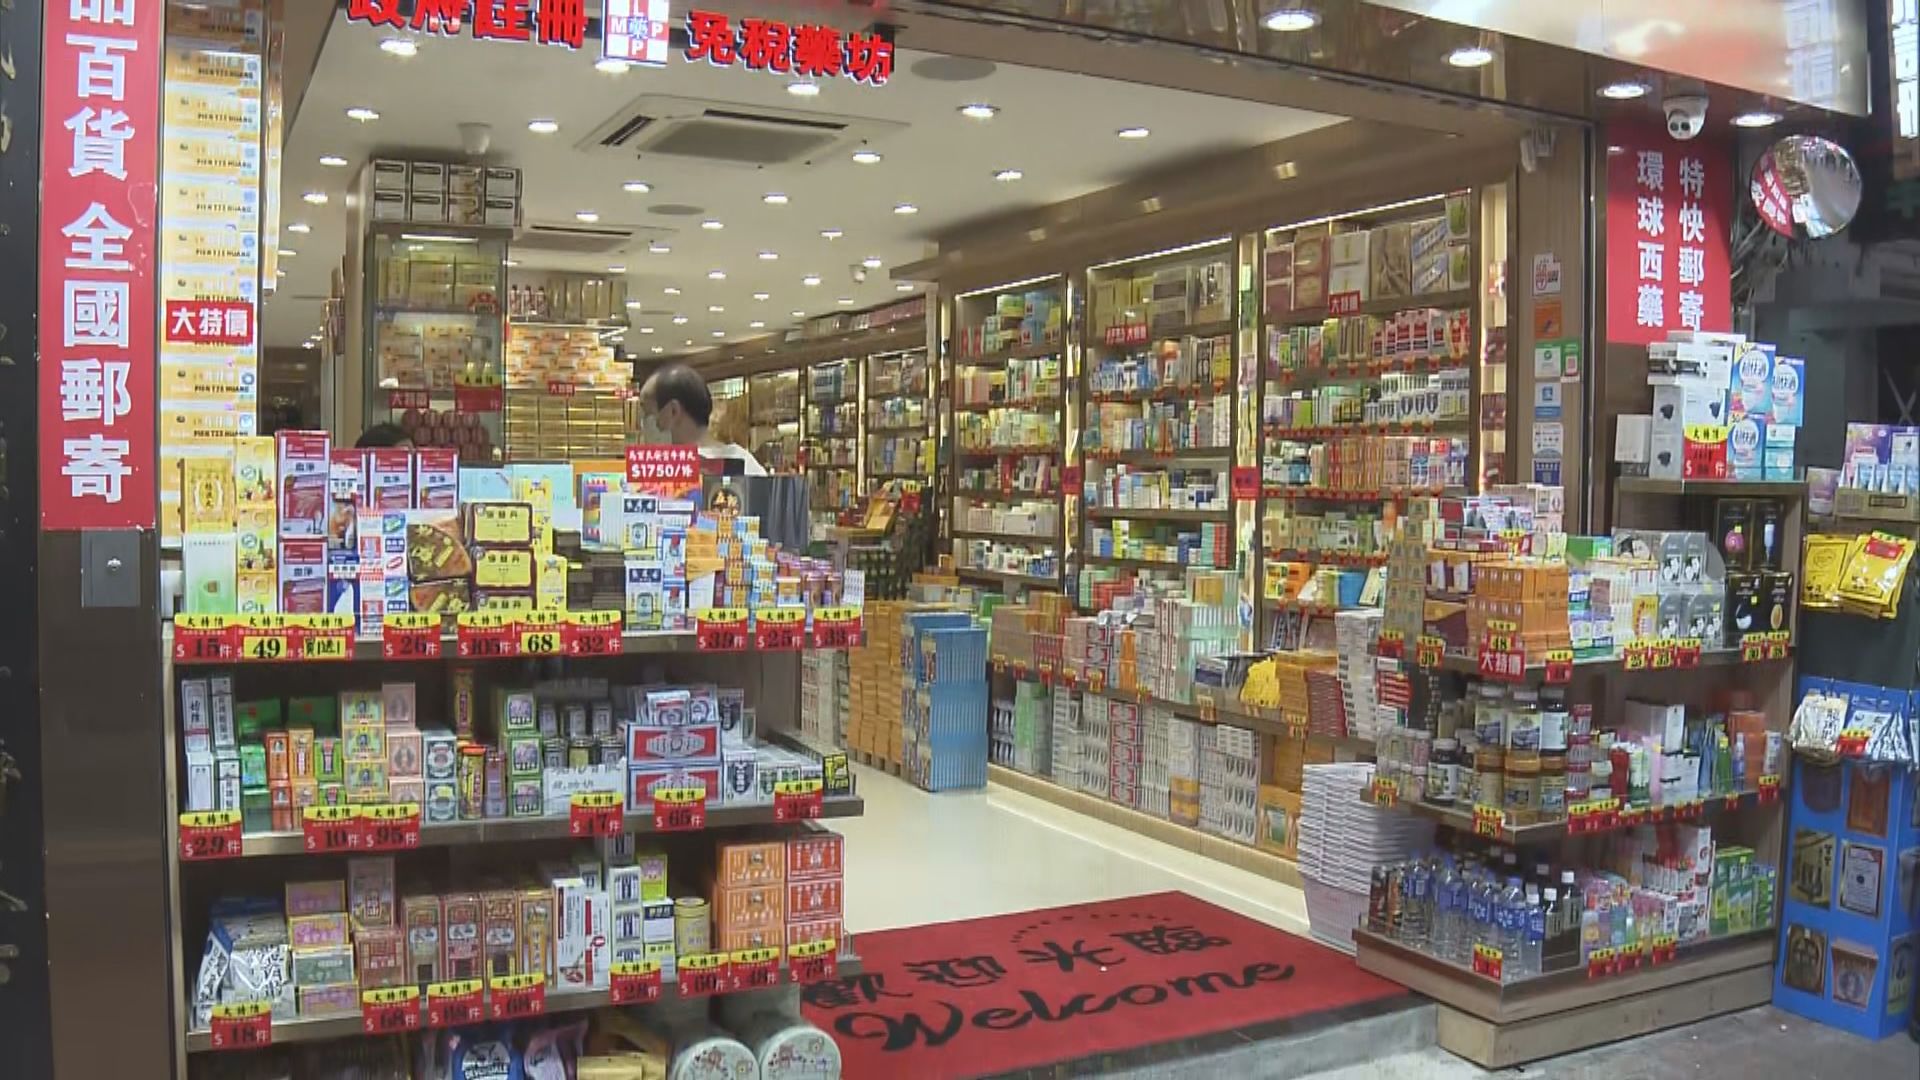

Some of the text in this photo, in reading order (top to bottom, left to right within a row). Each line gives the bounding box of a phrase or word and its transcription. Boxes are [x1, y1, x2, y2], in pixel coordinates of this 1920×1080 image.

[684, 9, 895, 86] 免稅藥坊
[1637, 150, 1664, 328] 環球西藥
[1678, 158, 1706, 331] 特快郵寄
[60, 202, 134, 503] 全國郵寄
[171, 307, 248, 337] 大特價
[252, 638, 281, 658] 49
[527, 634, 553, 653] 68
[834, 960, 1296, 1052] Welcome
